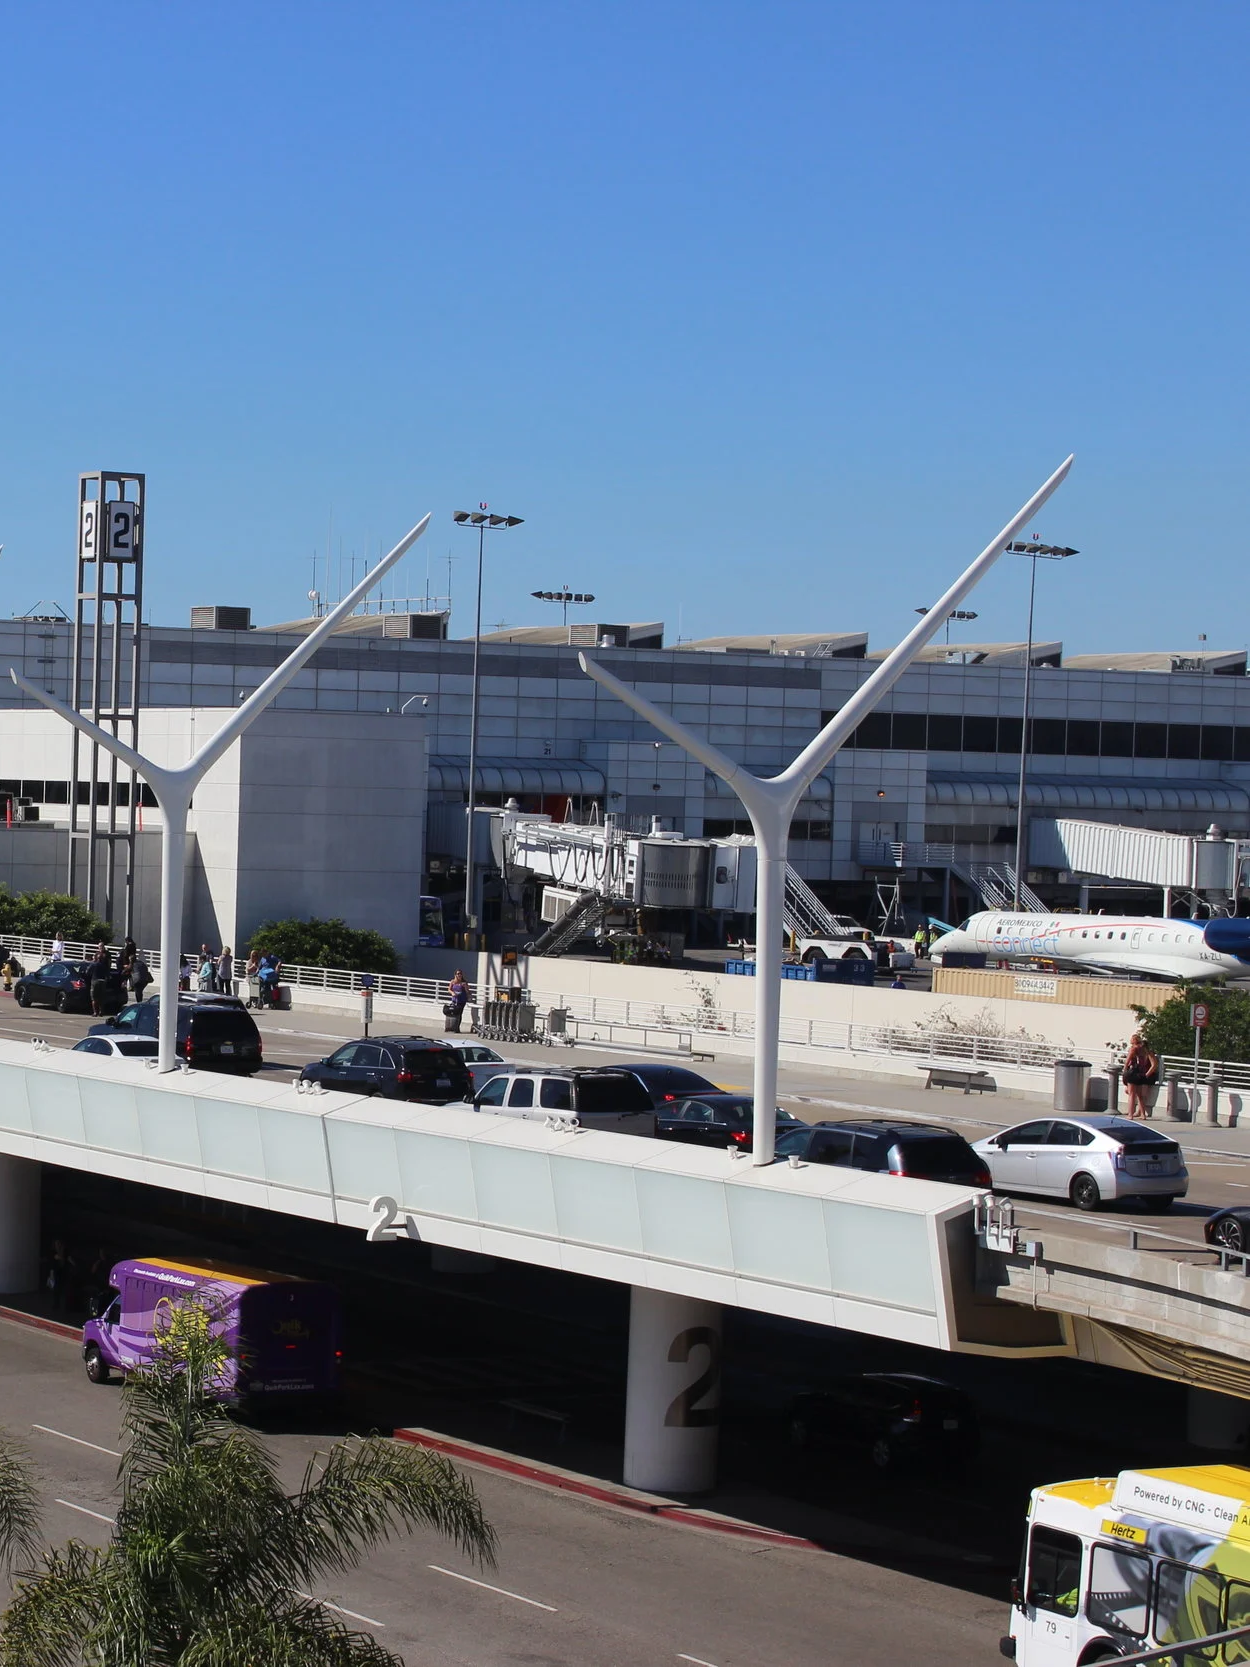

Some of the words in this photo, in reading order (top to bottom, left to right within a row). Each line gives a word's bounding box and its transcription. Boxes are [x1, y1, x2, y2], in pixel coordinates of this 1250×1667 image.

[85, 512, 94, 548] 2
[113, 512, 130, 548] 2
[544, 747, 552, 755] 21
[997, 919, 1043, 927] AEROMEXICO
[993, 935, 1062, 955] connect
[366, 1195, 397, 1241] 2
[664, 1326, 720, 1428] 2
[1133, 1486, 1169, 1505] Powered
[1171, 1496, 1182, 1510] by
[1184, 1499, 1205, 1514] CNG
[1214, 1507, 1239, 1523] Clean
[1111, 1523, 1136, 1539] Hertz
[1046, 1620, 1057, 1634] 79
